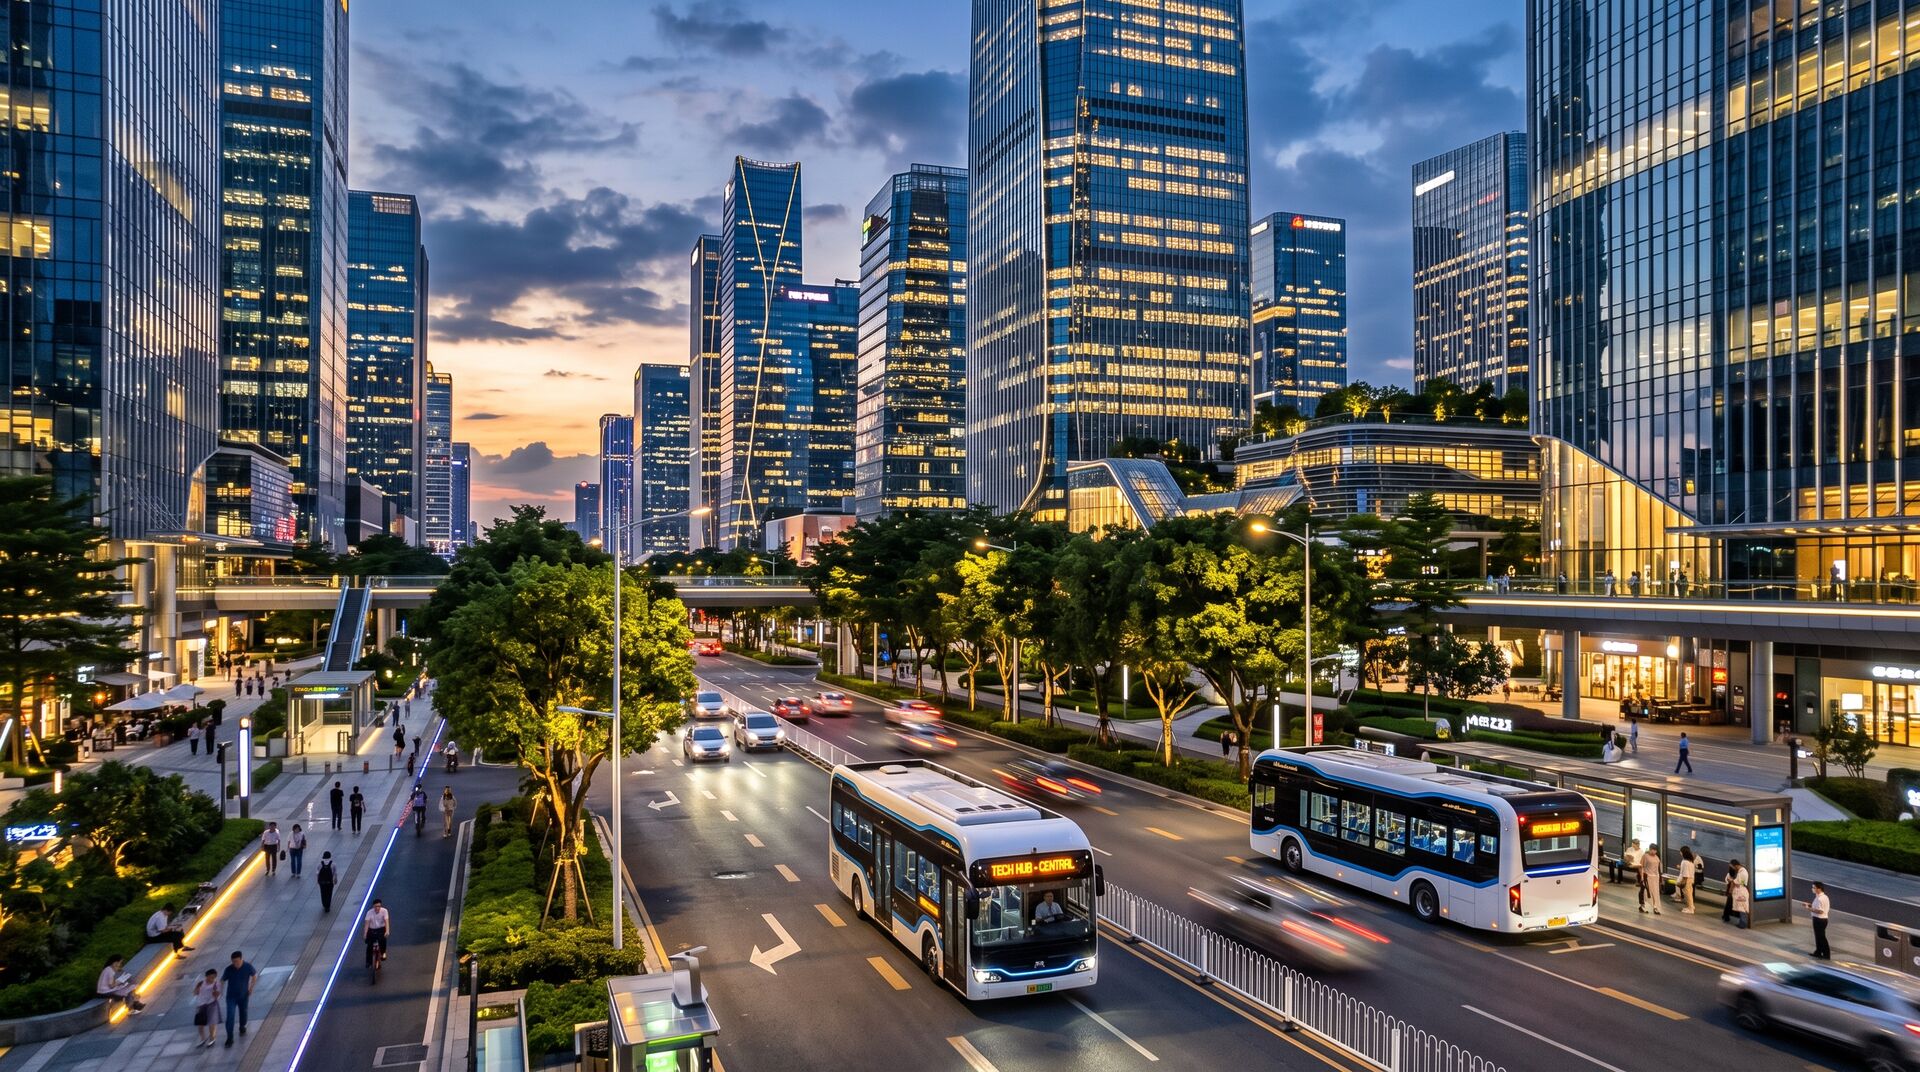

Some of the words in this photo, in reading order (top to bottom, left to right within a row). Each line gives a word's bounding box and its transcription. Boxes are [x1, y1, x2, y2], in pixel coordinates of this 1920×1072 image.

[991, 863, 1014, 877] TECH
[1015, 861, 1033, 875] HUB
[1039, 858, 1075, 872] CENTRAL
